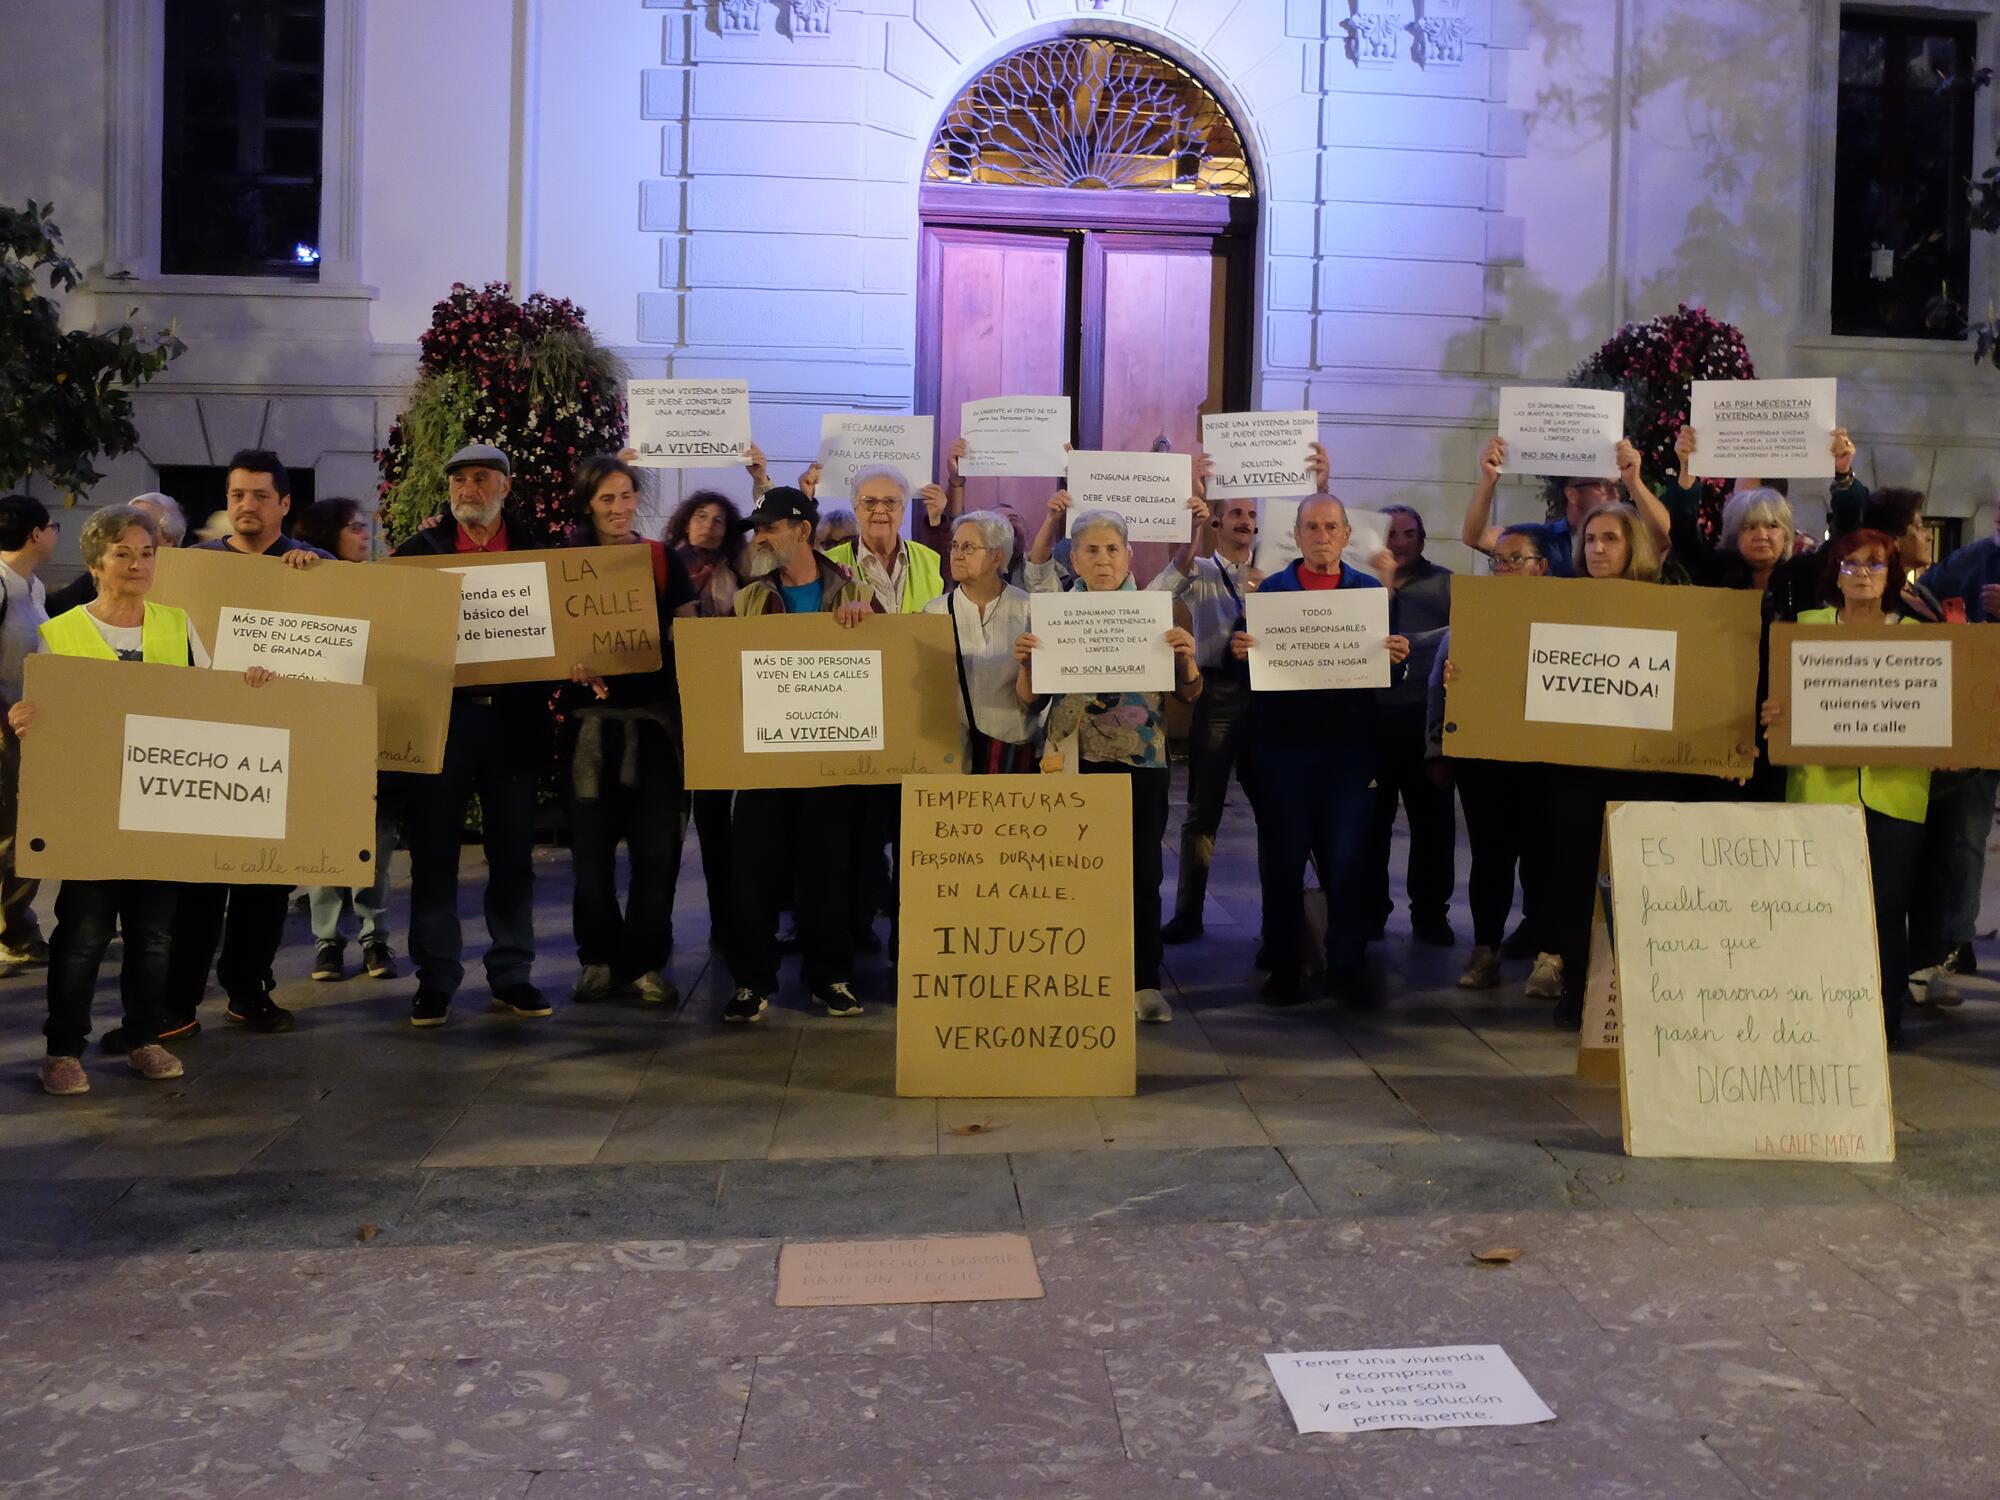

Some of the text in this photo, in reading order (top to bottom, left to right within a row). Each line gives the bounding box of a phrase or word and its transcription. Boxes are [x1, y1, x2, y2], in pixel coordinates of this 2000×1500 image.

[1714, 400, 1732, 409] LAS
[1756, 399, 1812, 408] NECESITAN
[1715, 411, 1810, 420] VIVIENDAS DIGNAS
[841, 423, 905, 433] RECLAMAMOS
[669, 442, 745, 454] VIVIENDA!!
[852, 438, 895, 447] VIVIENDA
[828, 449, 920, 460] PARA LAS PERSONAS
[1090, 473, 1170, 483] NINGUNA PERSONA
[1243, 471, 1311, 484] VIVIENDA!!
[1083, 494, 1176, 504] DEBE VERSE OBLIGADA
[1125, 516, 1176, 525] EN LA CALLE
[562, 559, 598, 583] LA
[501, 585, 531, 599] es el
[565, 589, 642, 618] CALLE
[463, 605, 529, 620] básico del
[1063, 609, 1073, 617] ES
[1302, 608, 1332, 617] TODOS
[232, 613, 358, 634] MÁS DE 300 PERSONAS
[1063, 618, 1094, 626] MANTAS
[1265, 624, 1367, 635] SOMOS RESPONSABLES
[233, 628, 353, 647] VIVEN EN LAS CALLES
[464, 625, 547, 641] de bienestar
[253, 643, 266, 652] DE
[592, 629, 652, 653] MATA
[1057, 637, 1076, 645] BAJO
[1275, 643, 1287, 651] DE
[1290, 642, 1330, 650] ATENDER
[1343, 641, 1360, 649] LAS
[753, 654, 871, 666] MÁS DE 300 PERSONAS
[1268, 658, 1368, 668] PERSONAS SIN HOGAR
[1532, 649, 1671, 672] ¡DERECHO A LA
[1799, 653, 1943, 668] Viviendas y Centros
[756, 670, 869, 680] VIVEN EN LAS CALLES
[1082, 665, 1102, 674] SON
[777, 684, 791, 693] DE
[1542, 674, 1659, 698] VIVIENDA!
[1803, 677, 1938, 690] permanentes para
[1820, 697, 1920, 711] quienes viven
[785, 708, 842, 720] SOLUCIÓN:
[757, 726, 877, 741] ¡¡LA VIVIENDA!!
[1834, 720, 1906, 733] en la calle
[128, 745, 283, 774] ¡DERECHO A LA
[139, 776, 270, 803] VIVIENDA!
[914, 789, 1087, 813] TEMPERATURAS
[935, 821, 1088, 840] BAJO CERO Y
[911, 850, 984, 870] PERSONAS
[1641, 837, 1818, 868] ES URGENTE
[214, 848, 344, 874] La calle mata
[937, 883, 1075, 900] EN LA CALLE.
[1641, 886, 1833, 931] facilitar espacios
[933, 927, 1086, 955] INJUSTO
[1646, 936, 1761, 969] para que
[912, 973, 1112, 999] INTOLERABLE
[1650, 973, 1873, 1021] las personas sin hogar
[935, 1025, 1116, 1050] VERGONZOSO
[1654, 1016, 1821, 1058] pasen el día
[1697, 1064, 1868, 1109] DIGNAMENTE
[1755, 1134, 1866, 1155] LA CALLE MATA
[1292, 1353, 1485, 1369] Tener una vivienda
[1335, 1367, 1453, 1381] recompone
[1340, 1381, 1467, 1395] a la persona
[1318, 1393, 1502, 1413] y es una solución
[1353, 1410, 1493, 1427] permanente.
